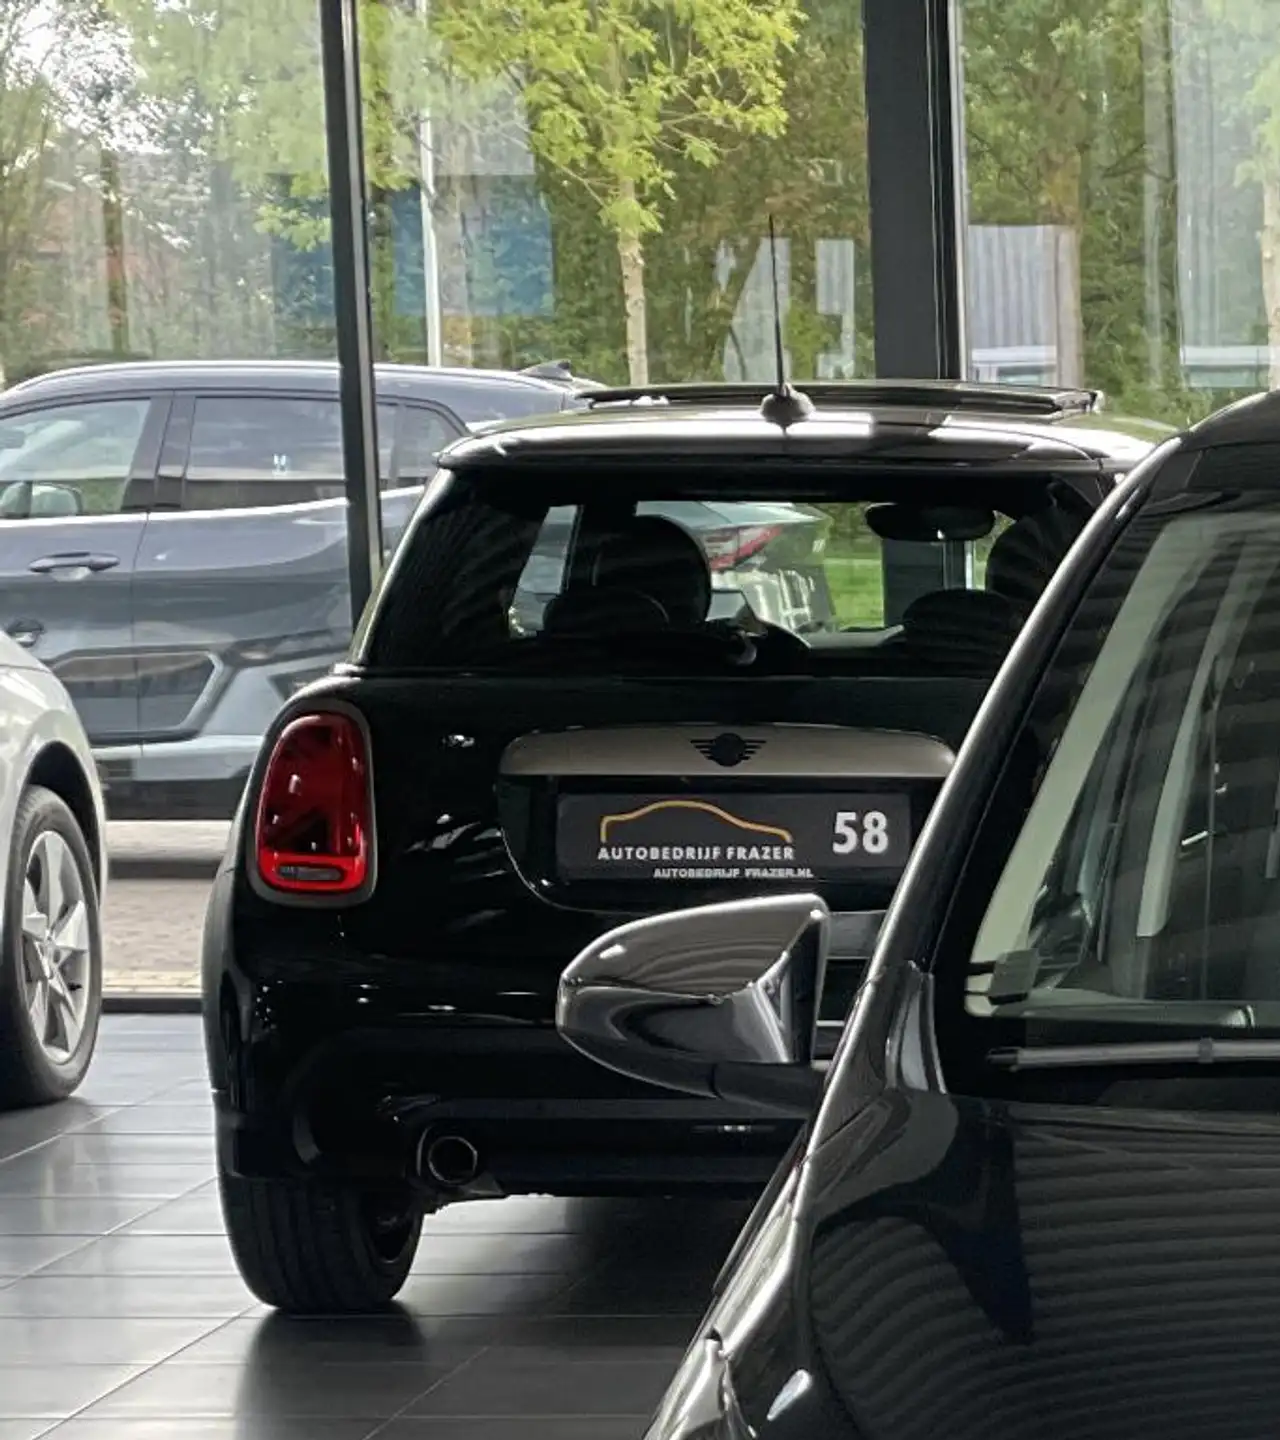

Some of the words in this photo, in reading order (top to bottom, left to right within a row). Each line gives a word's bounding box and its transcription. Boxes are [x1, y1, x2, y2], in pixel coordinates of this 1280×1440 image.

[832, 810, 889, 854] 58
[598, 846, 721, 861] AUTOBEDRIJF
[726, 846, 795, 861] FRAZER
[653, 867, 741, 879] AUTOBEDRIJF
